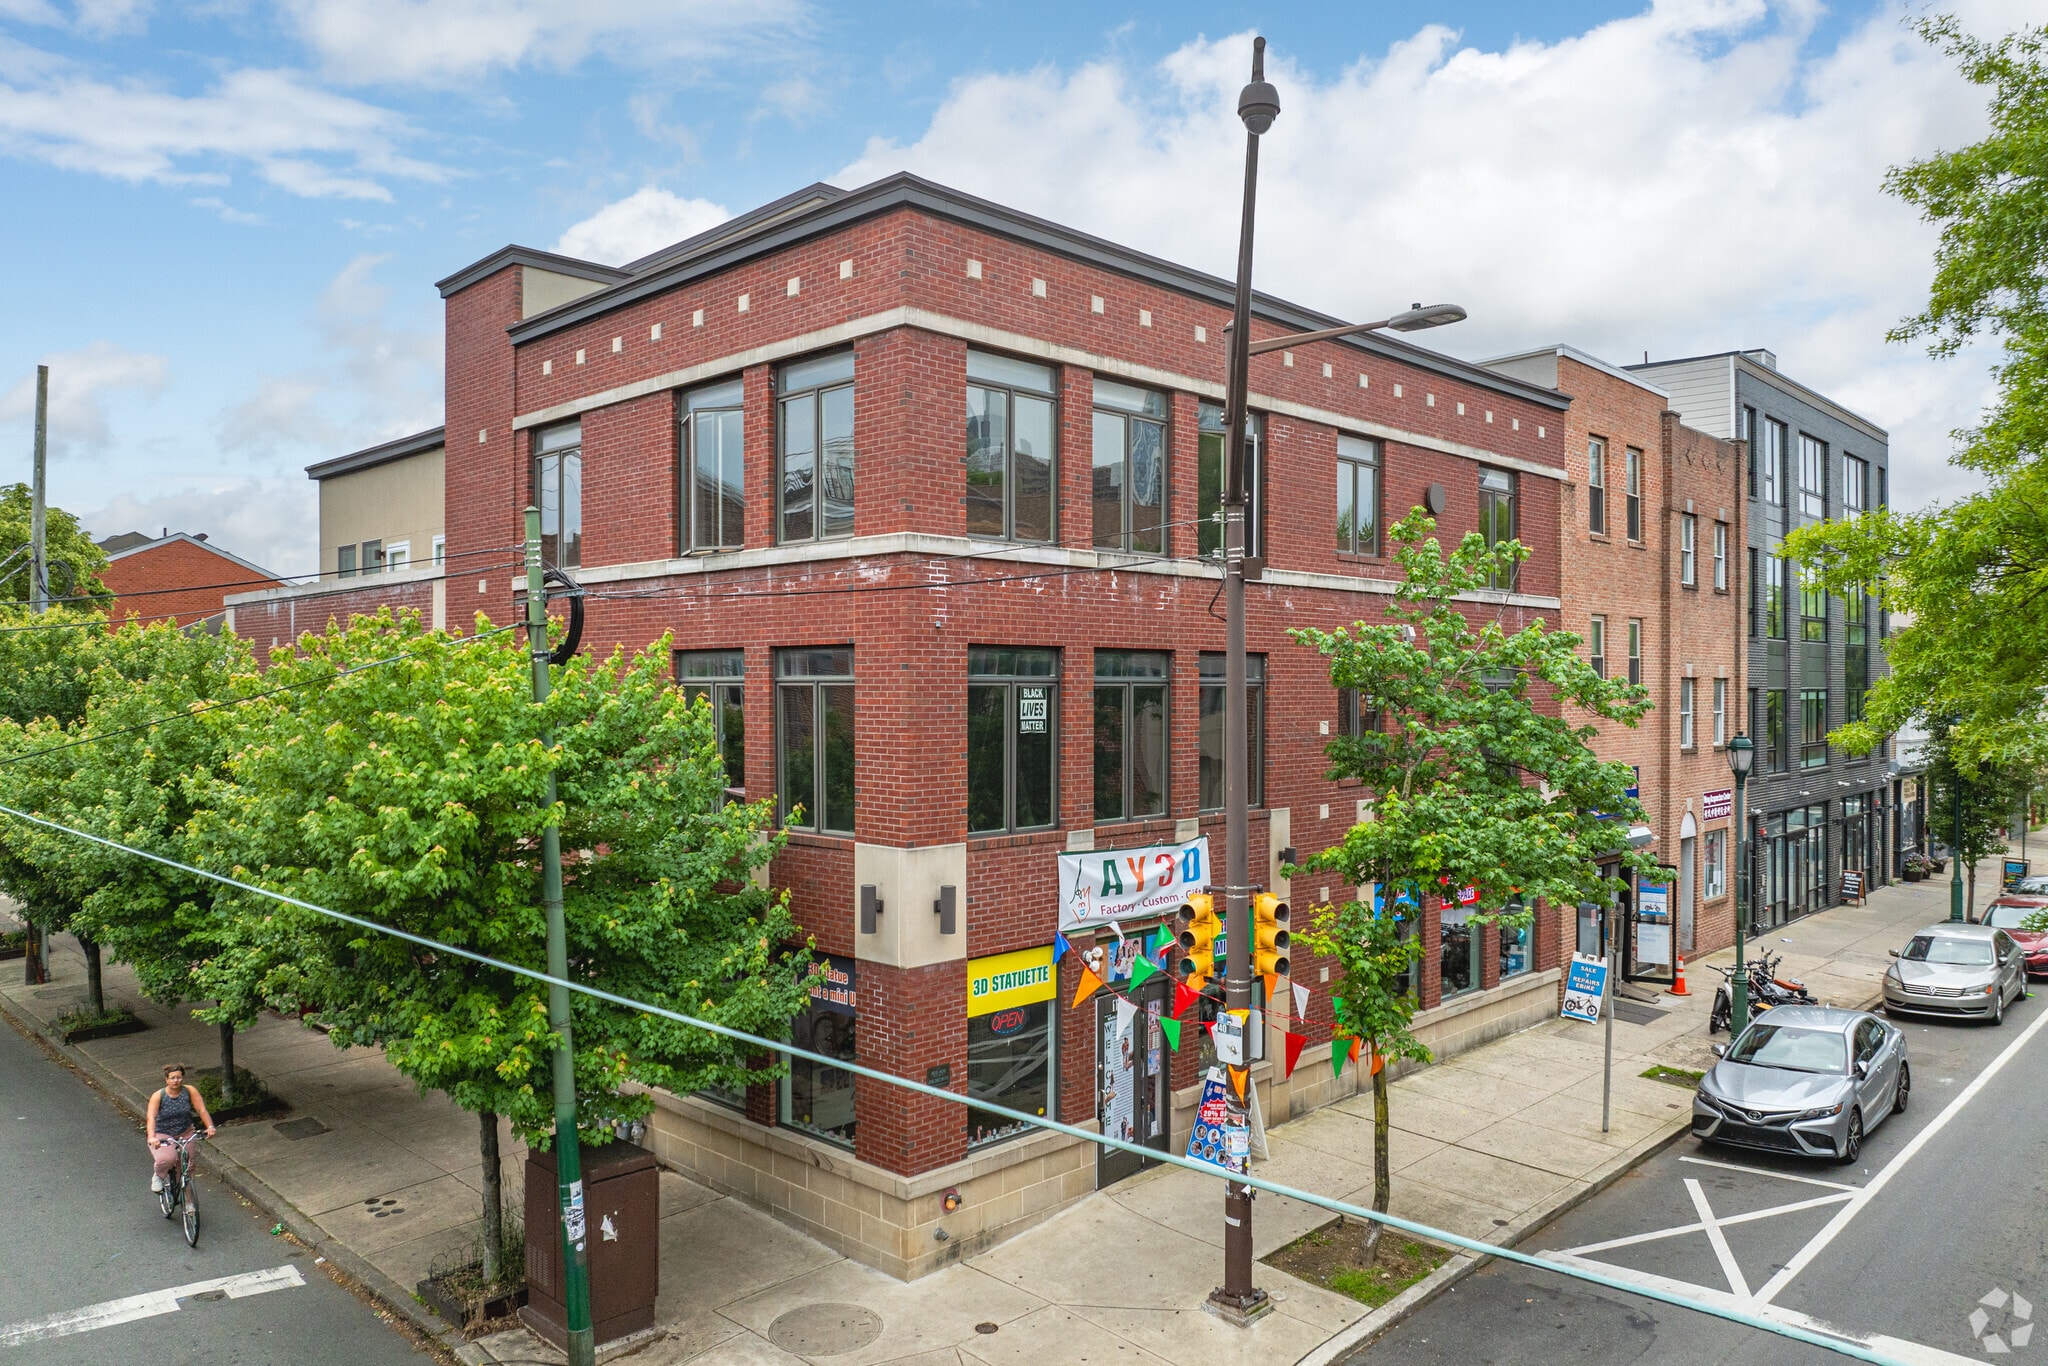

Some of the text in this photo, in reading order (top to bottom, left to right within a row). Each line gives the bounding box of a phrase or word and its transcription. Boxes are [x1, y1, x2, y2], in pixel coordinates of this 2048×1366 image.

[1023, 688, 1044, 698] BLACK
[1022, 702, 1044, 717] LIVES
[1021, 720, 1044, 730] MATTER
[1100, 847, 1201, 897] AY3D
[1101, 901, 1136, 915] Factory
[1142, 894, 1179, 908] Custom
[823, 966, 848, 985] tatue
[973, 965, 1049, 996] 3D STATUETTE
[1573, 976, 1600, 986] REPAIRS
[1575, 983, 1595, 991] EBIKE
[822, 988, 828, 1000] a
[830, 988, 848, 1005] mini
[992, 1010, 1024, 1031] OPEN
[1104, 1023, 1112, 1127] WELCOME
